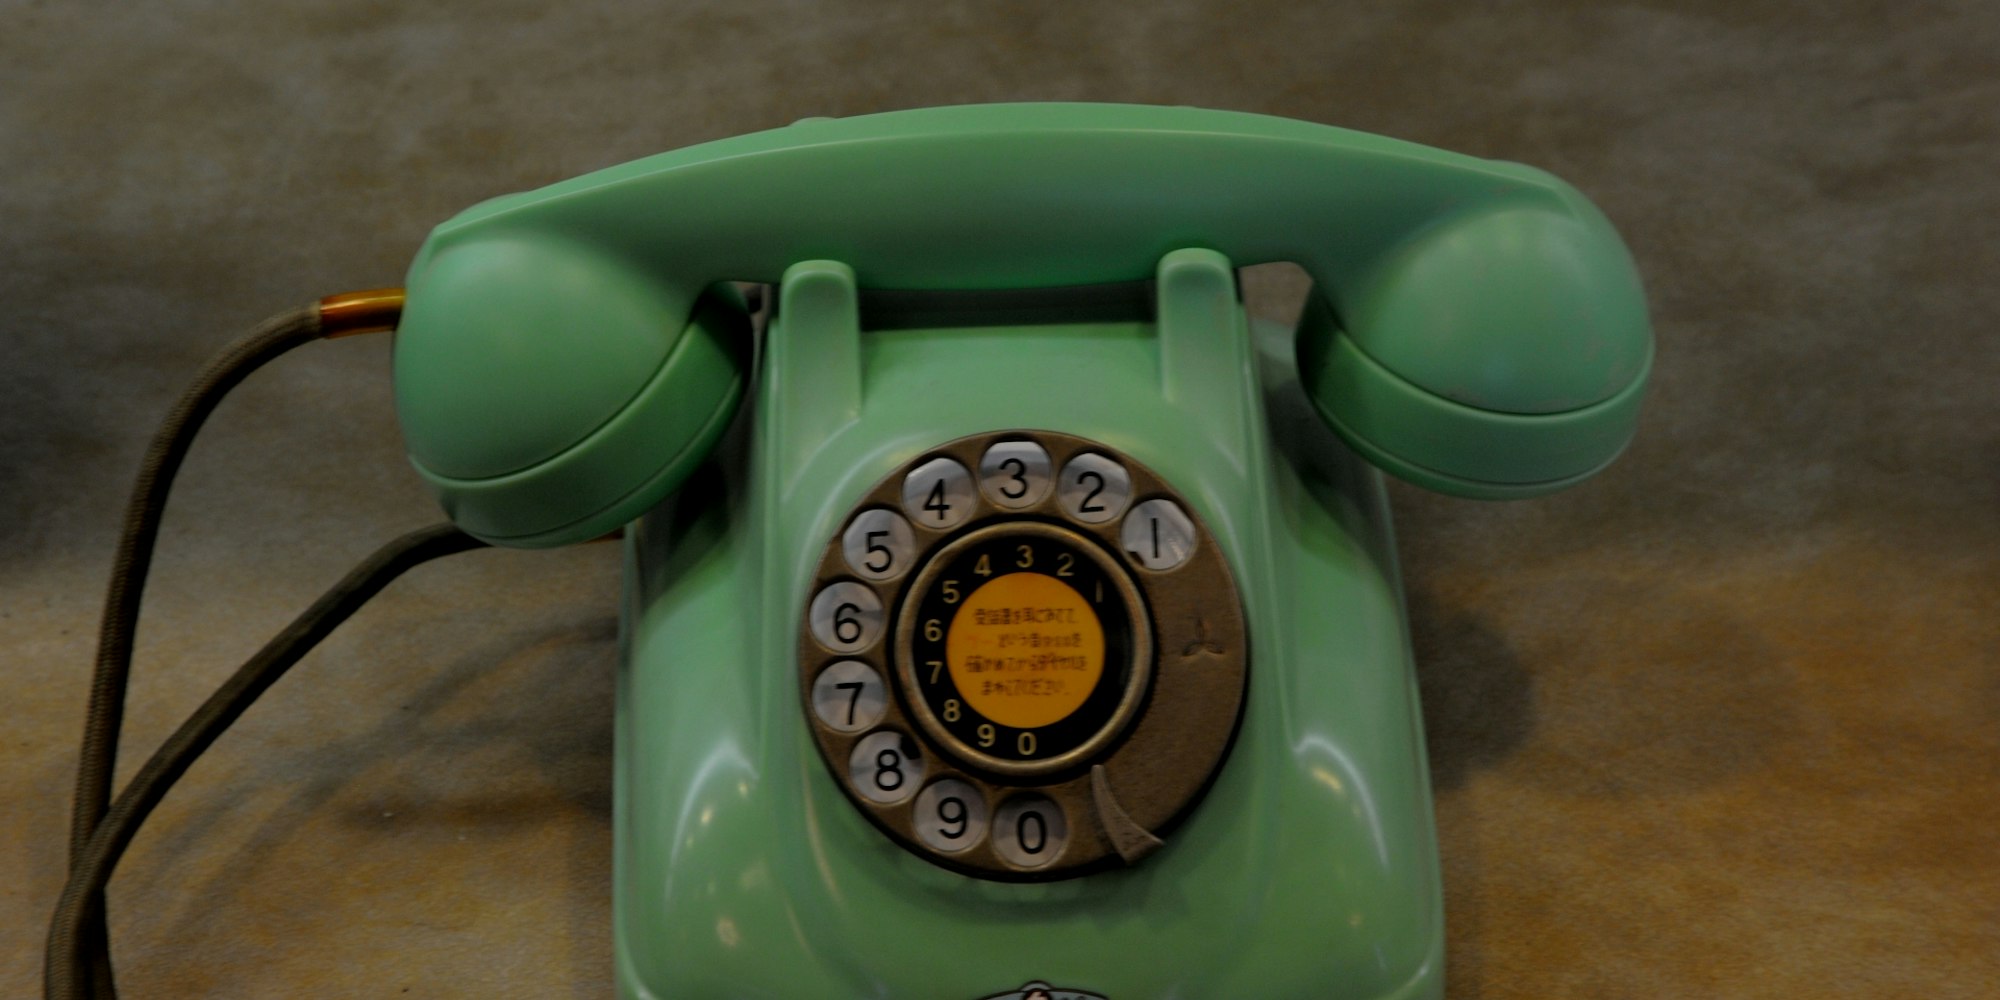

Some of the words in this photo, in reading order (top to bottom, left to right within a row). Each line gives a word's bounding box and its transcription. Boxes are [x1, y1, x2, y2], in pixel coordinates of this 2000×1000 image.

[997, 458, 1028, 499] 3
[1076, 471, 1105, 513] 2
[923, 478, 950, 521] 4
[865, 530, 893, 573] 5
[1016, 545, 1034, 569] 3
[1151, 517, 1159, 559] 1
[973, 554, 992, 577] 4
[1057, 553, 1075, 576] 2
[942, 580, 960, 604] 5
[833, 602, 862, 644] 6
[925, 618, 942, 642] 6
[925, 660, 943, 684] 7
[835, 681, 865, 726] 7
[943, 698, 962, 723] 8
[977, 723, 996, 748] 9
[1017, 731, 1036, 756] 0
[874, 749, 903, 792] 8
[936, 796, 968, 840] 9
[1016, 810, 1046, 854] 0
